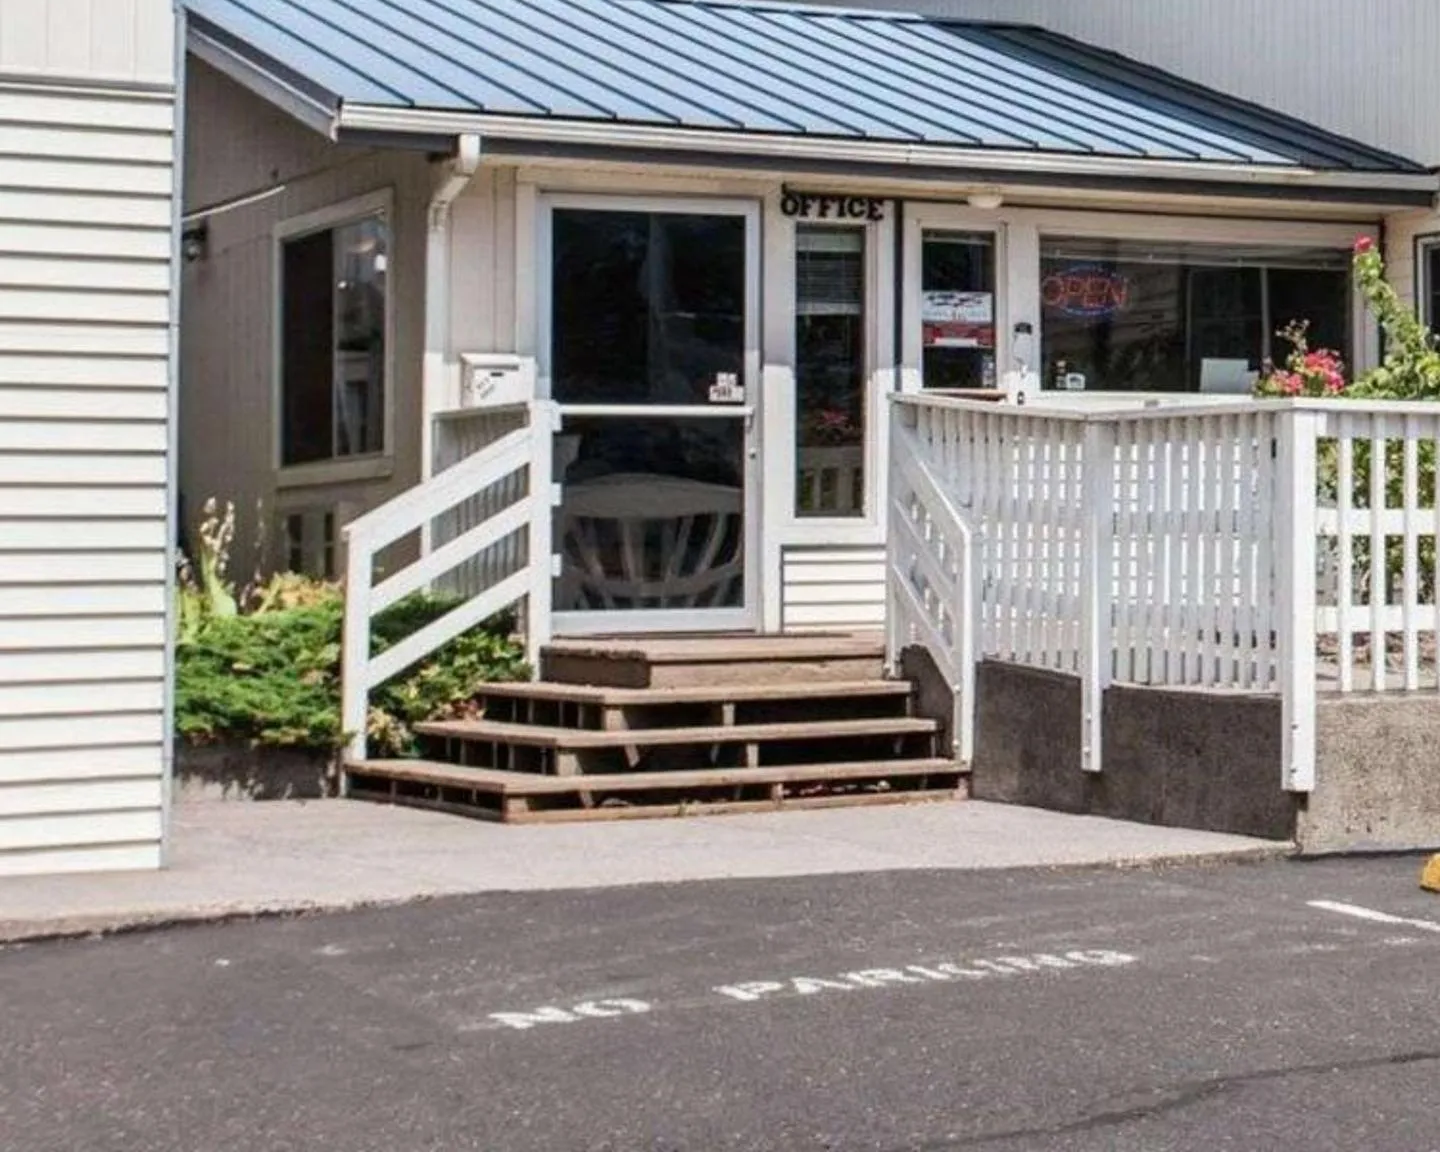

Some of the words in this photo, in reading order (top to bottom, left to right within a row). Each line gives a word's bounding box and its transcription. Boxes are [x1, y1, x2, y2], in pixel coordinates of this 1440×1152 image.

[780, 194, 884, 221] OFFICE
[1042, 275, 1128, 308] OPEN
[488, 998, 651, 1029] NO
[712, 949, 1138, 1001] PARKING
